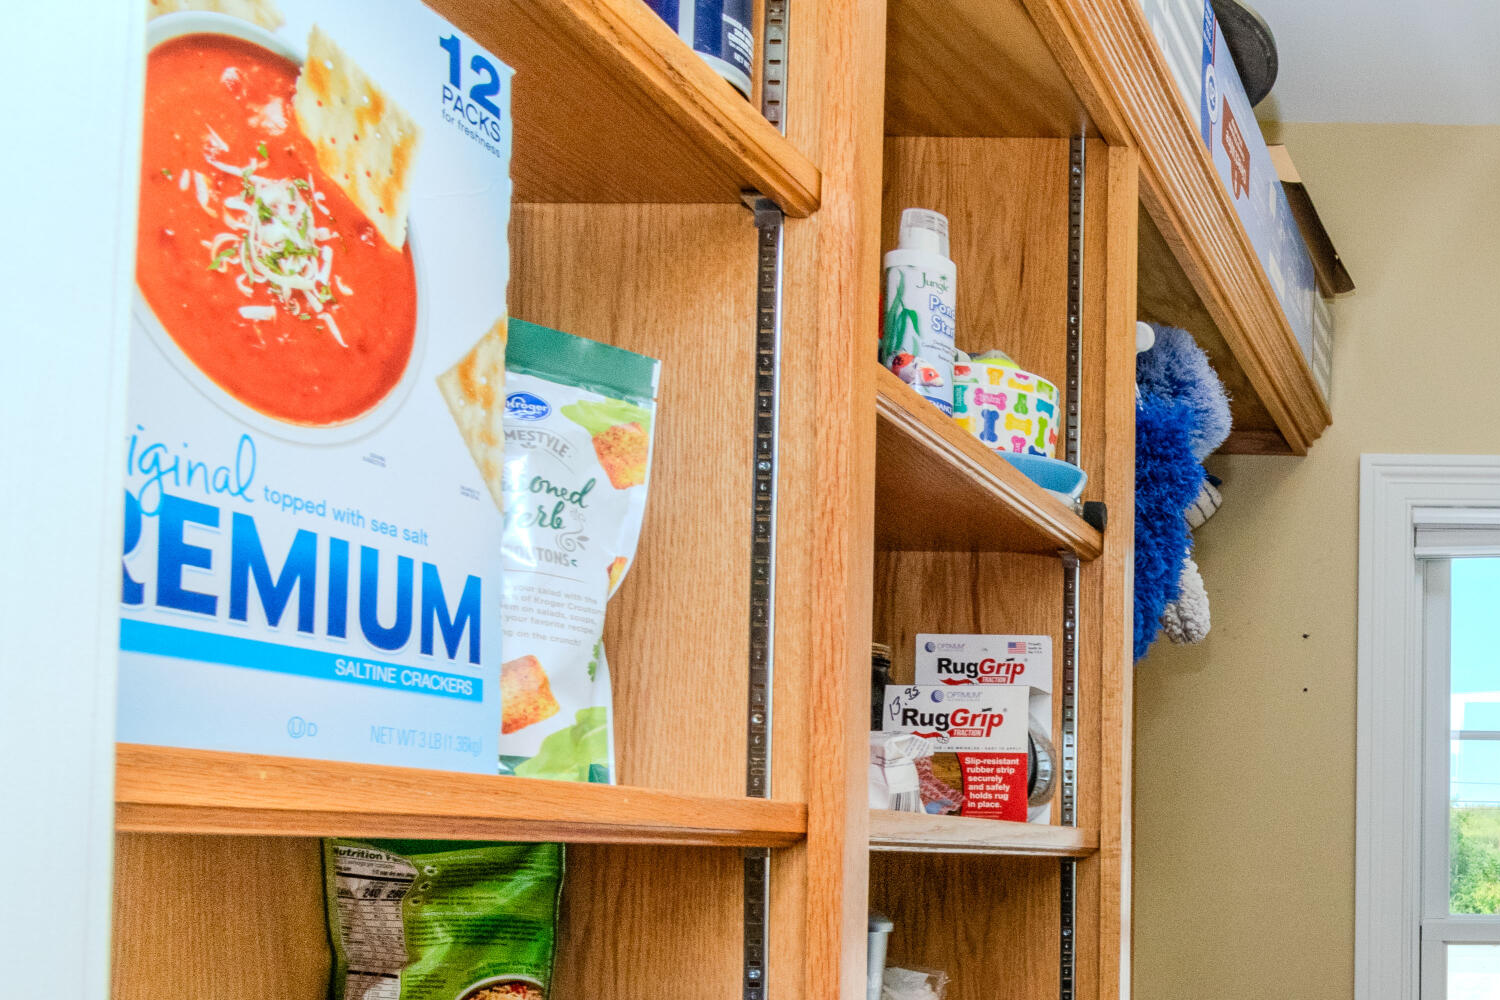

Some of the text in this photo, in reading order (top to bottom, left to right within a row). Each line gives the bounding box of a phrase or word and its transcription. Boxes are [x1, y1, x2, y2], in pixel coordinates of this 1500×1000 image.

[439, 33, 501, 121] 12
[442, 84, 501, 142] PACKS
[504, 428, 570, 459] MESTYLE
[127, 424, 429, 547] iginal topped with sea salt
[121, 487, 482, 666] REMIUM
[334, 658, 474, 697] SALTINE CRACKERS
[937, 656, 1026, 685] RugGrip
[901, 707, 1005, 739] RugGrip
[964, 756, 1021, 768] Slip-resistant
[966, 765, 1016, 775] rubber strip
[967, 775, 1004, 785] securely
[968, 783, 1012, 793] and safely
[967, 801, 1004, 810] in place.
[969, 791, 1010, 802] holds rug
